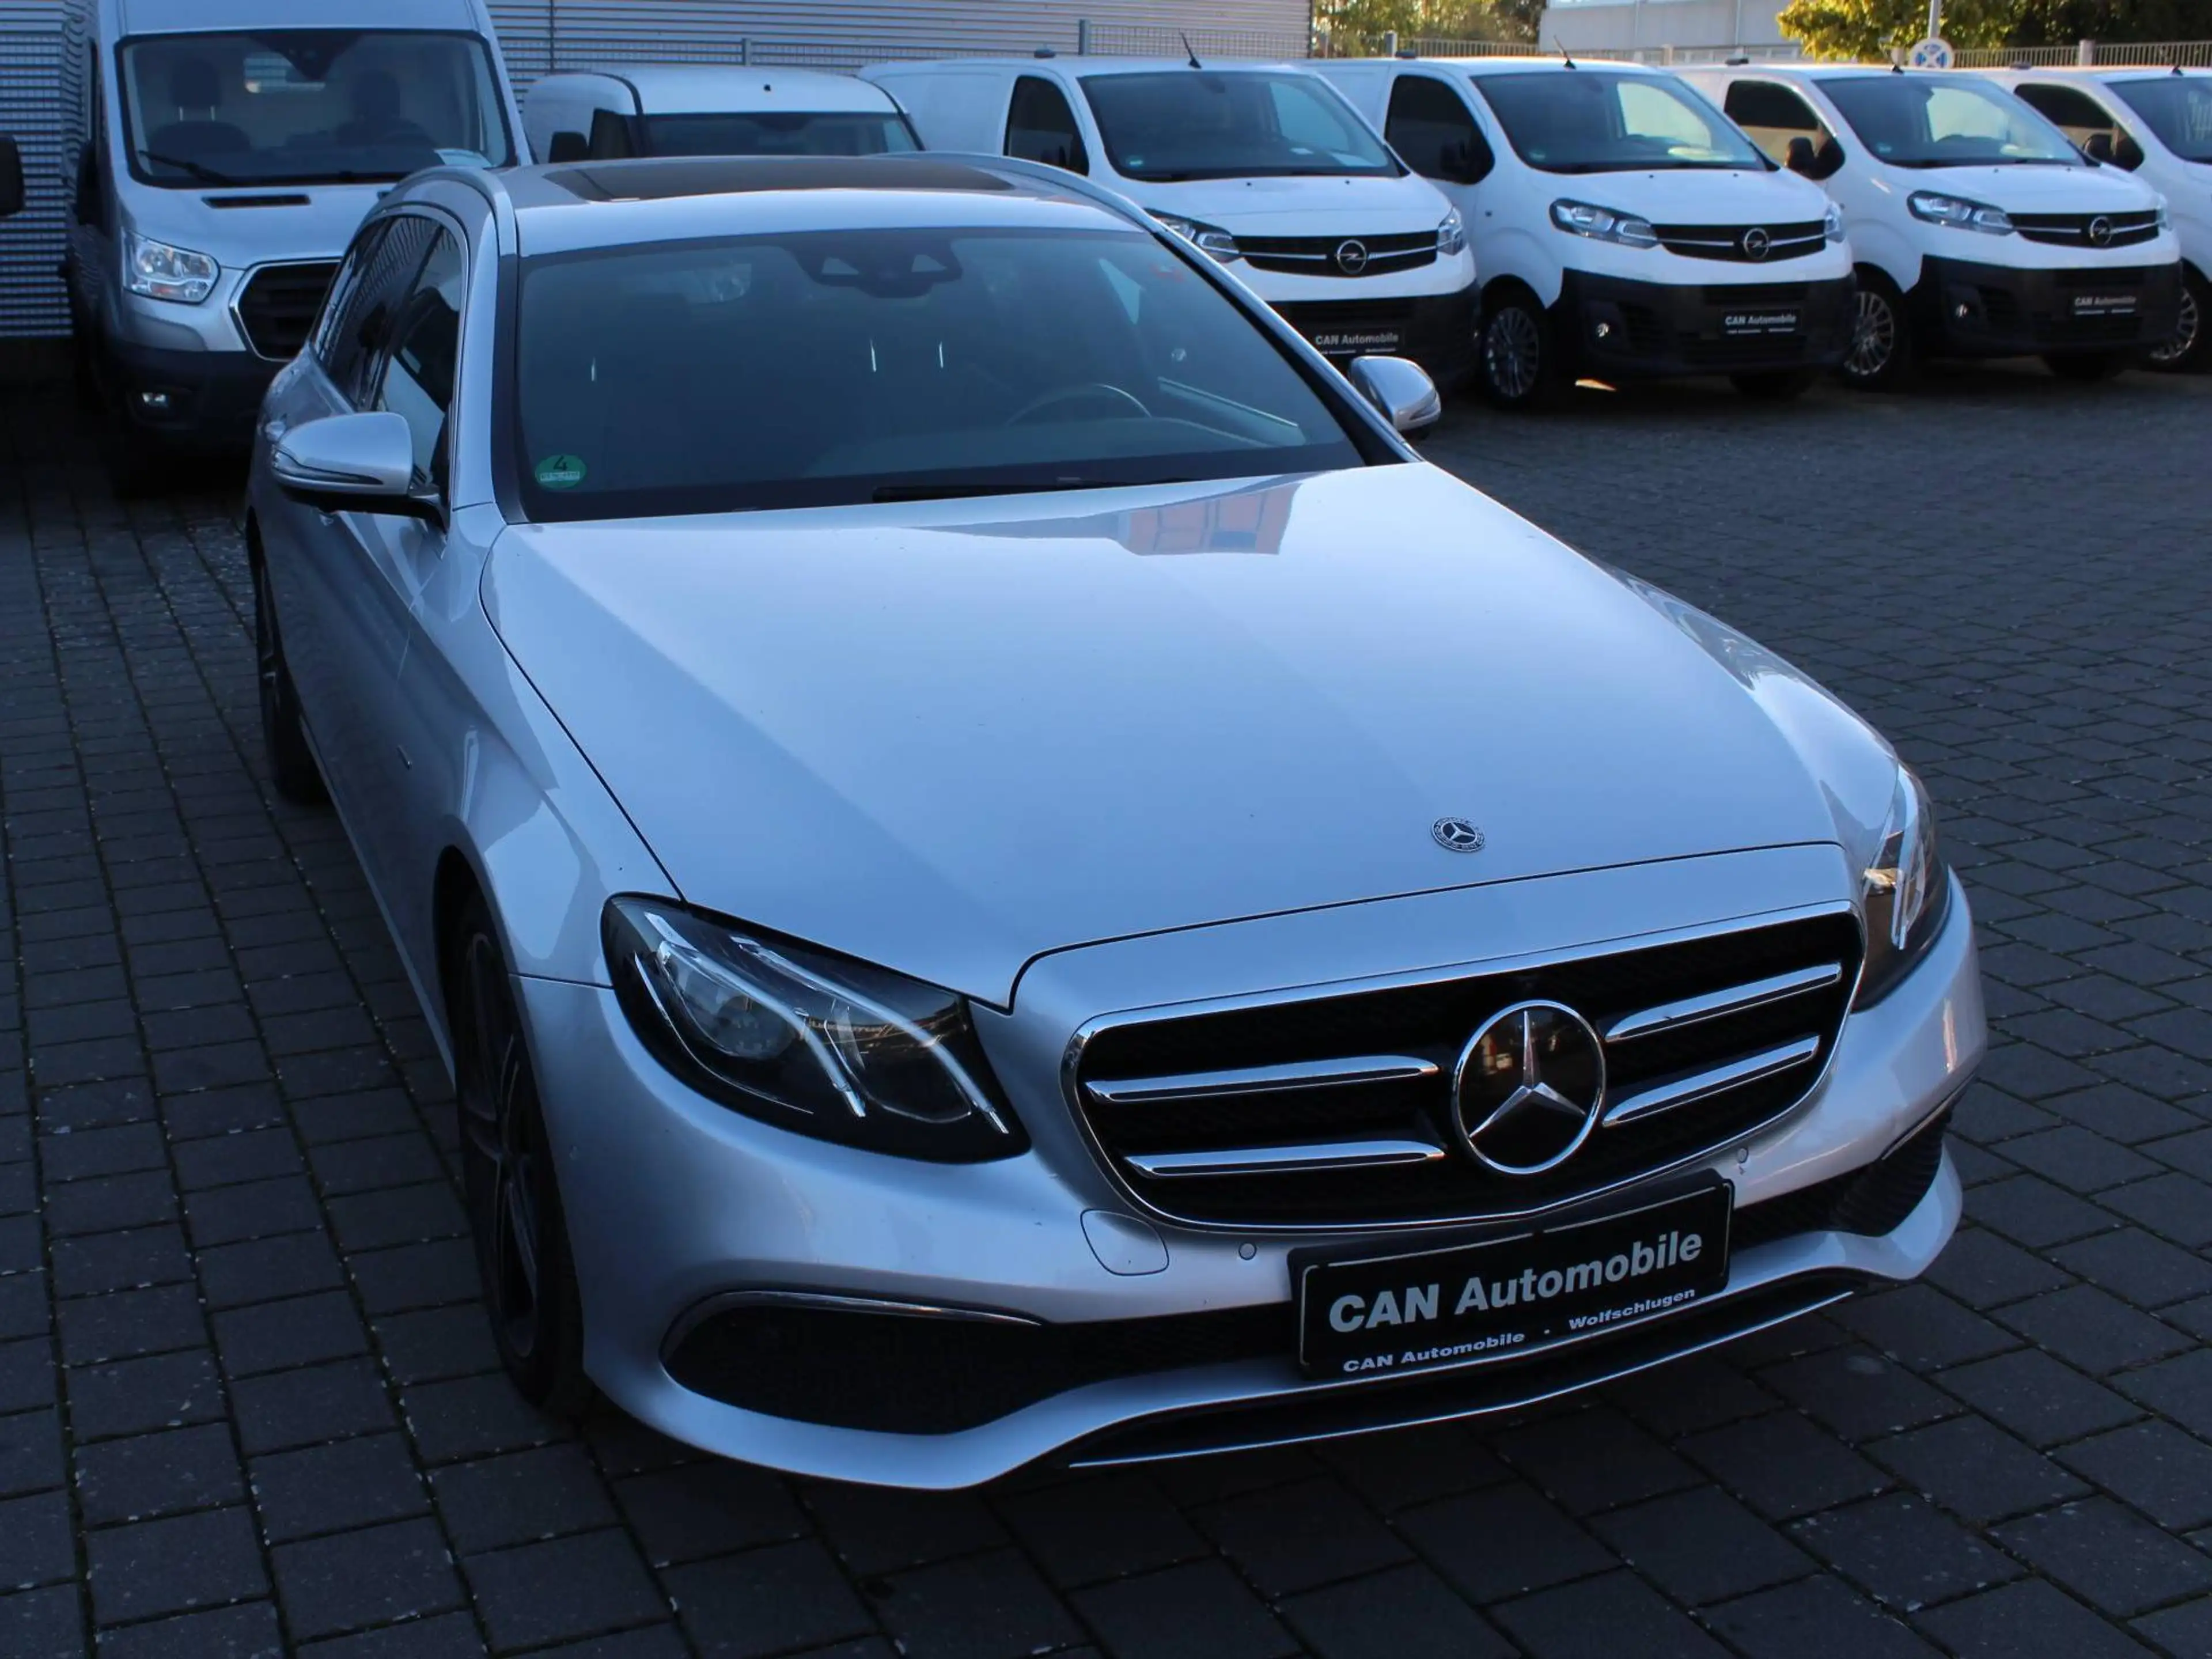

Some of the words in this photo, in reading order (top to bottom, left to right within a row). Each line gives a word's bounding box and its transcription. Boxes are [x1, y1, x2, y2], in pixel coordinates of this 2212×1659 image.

[1725, 316, 1746, 326] CAN
[1315, 334, 1339, 346] CAN
[1342, 331, 1399, 345] Automobile
[553, 454, 569, 471] 4
[1329, 1283, 1440, 1332] CAN
[1455, 1230, 1703, 1315] Automobile
[1343, 1354, 1393, 1373] CAN
[1400, 1331, 1525, 1364] Automobile
[1568, 1288, 1696, 1330] Wolfschlugen
